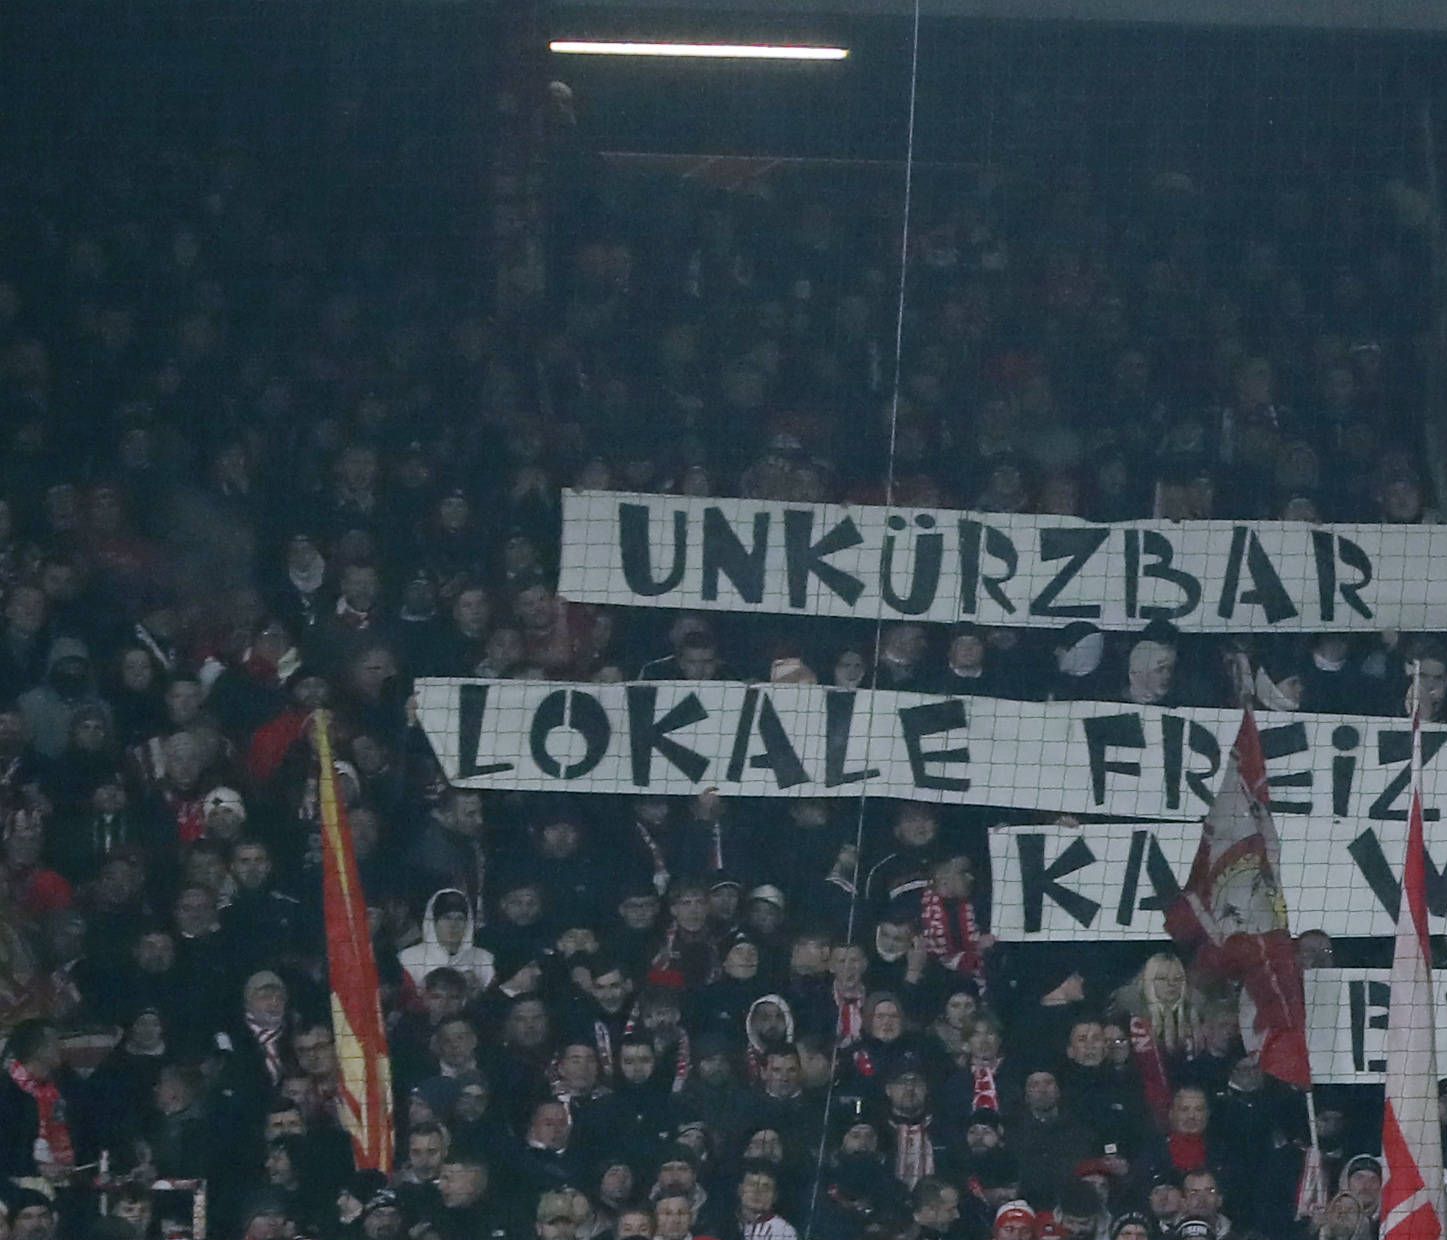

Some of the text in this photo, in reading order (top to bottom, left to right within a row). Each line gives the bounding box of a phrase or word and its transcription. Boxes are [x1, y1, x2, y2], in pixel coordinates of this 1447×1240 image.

[618, 503, 1373, 625] UNKÜRZBAR
[457, 684, 970, 792] LOKALE
[1016, 832, 1186, 934] KA
